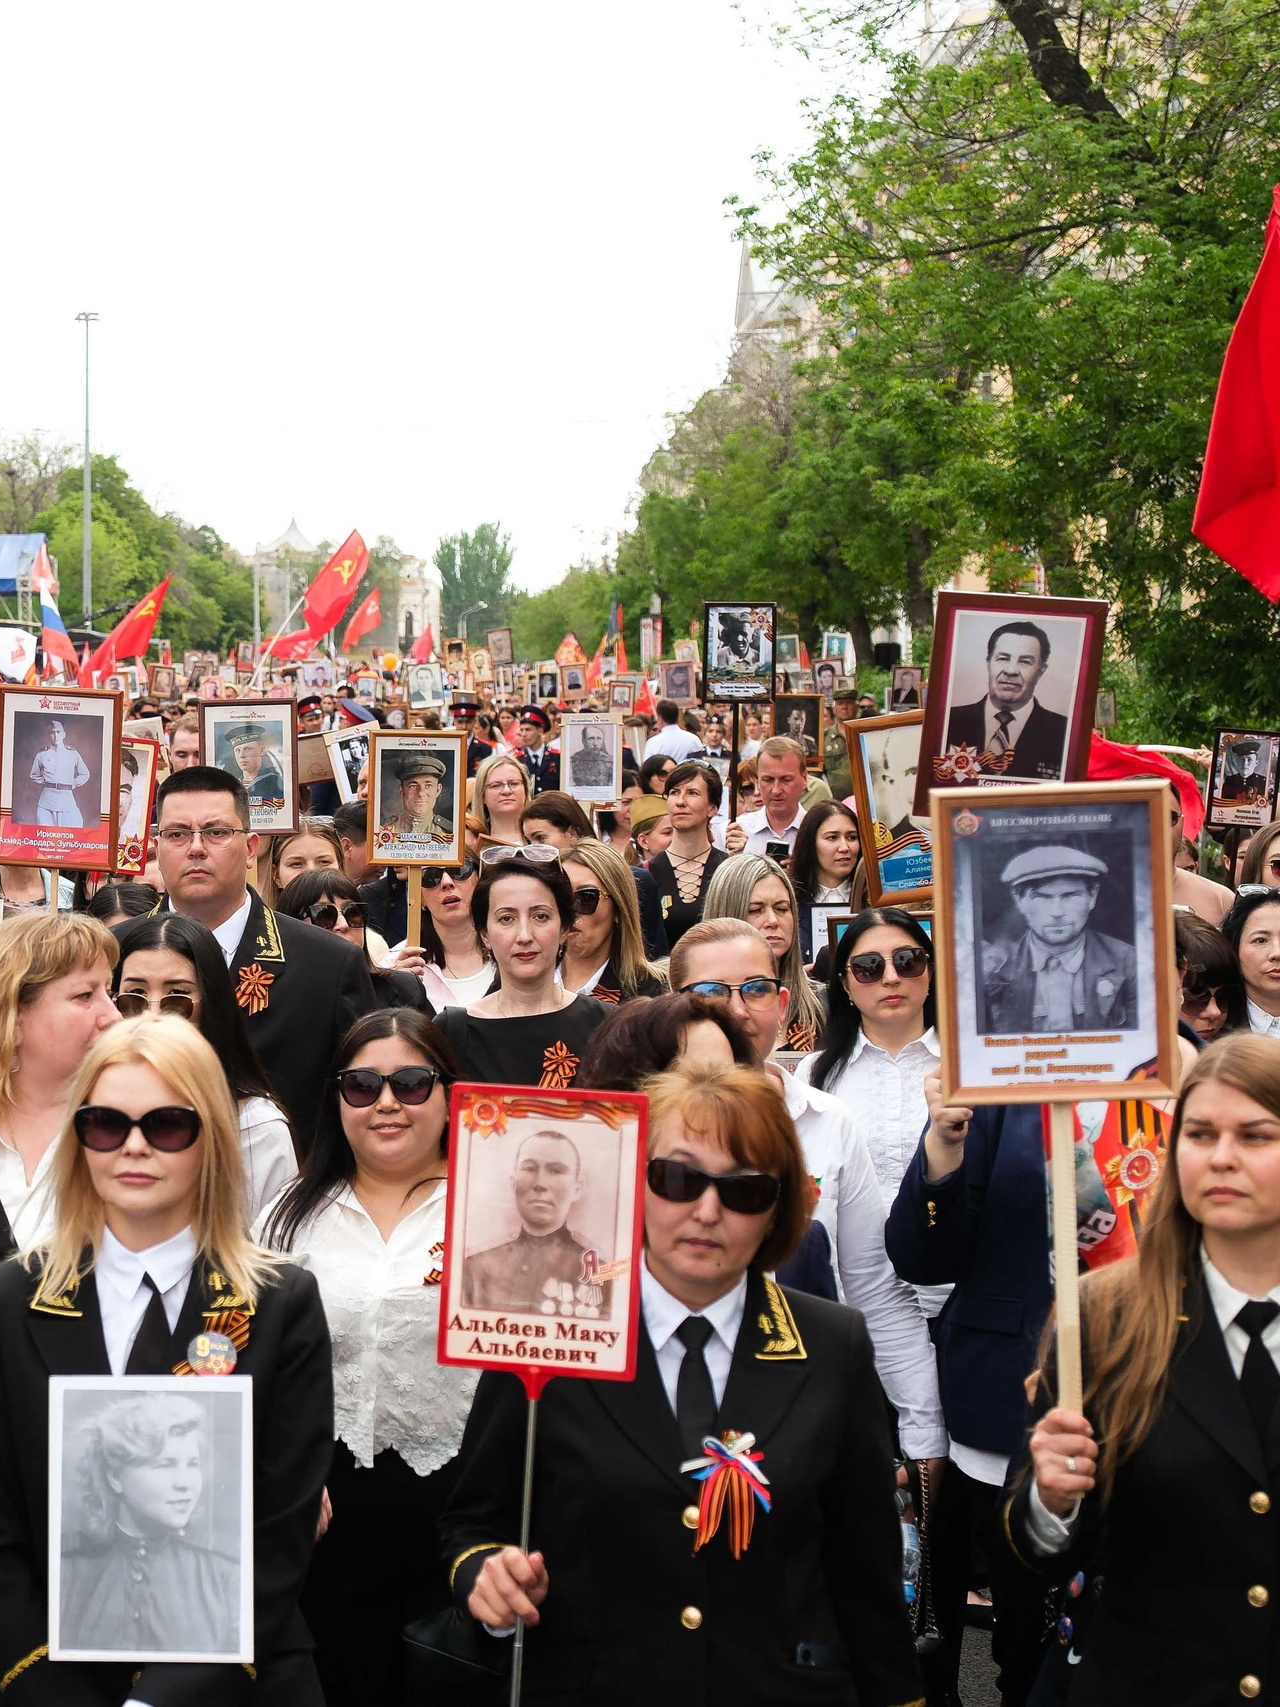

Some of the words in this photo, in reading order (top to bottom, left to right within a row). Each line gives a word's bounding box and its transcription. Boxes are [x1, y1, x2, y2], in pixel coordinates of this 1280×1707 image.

[990, 814, 1077, 828] БЕССМЕРТНЫЙ
[1078, 813, 1113, 824] ПОЛК
[905, 865, 933, 874] Алиме
[1025, 1048, 1068, 1061] рядовой
[448, 1313, 547, 1337] Альбаев
[554, 1321, 622, 1348] Маку
[196, 1335, 210, 1357] 9
[467, 1336, 598, 1364] Альбаевич
